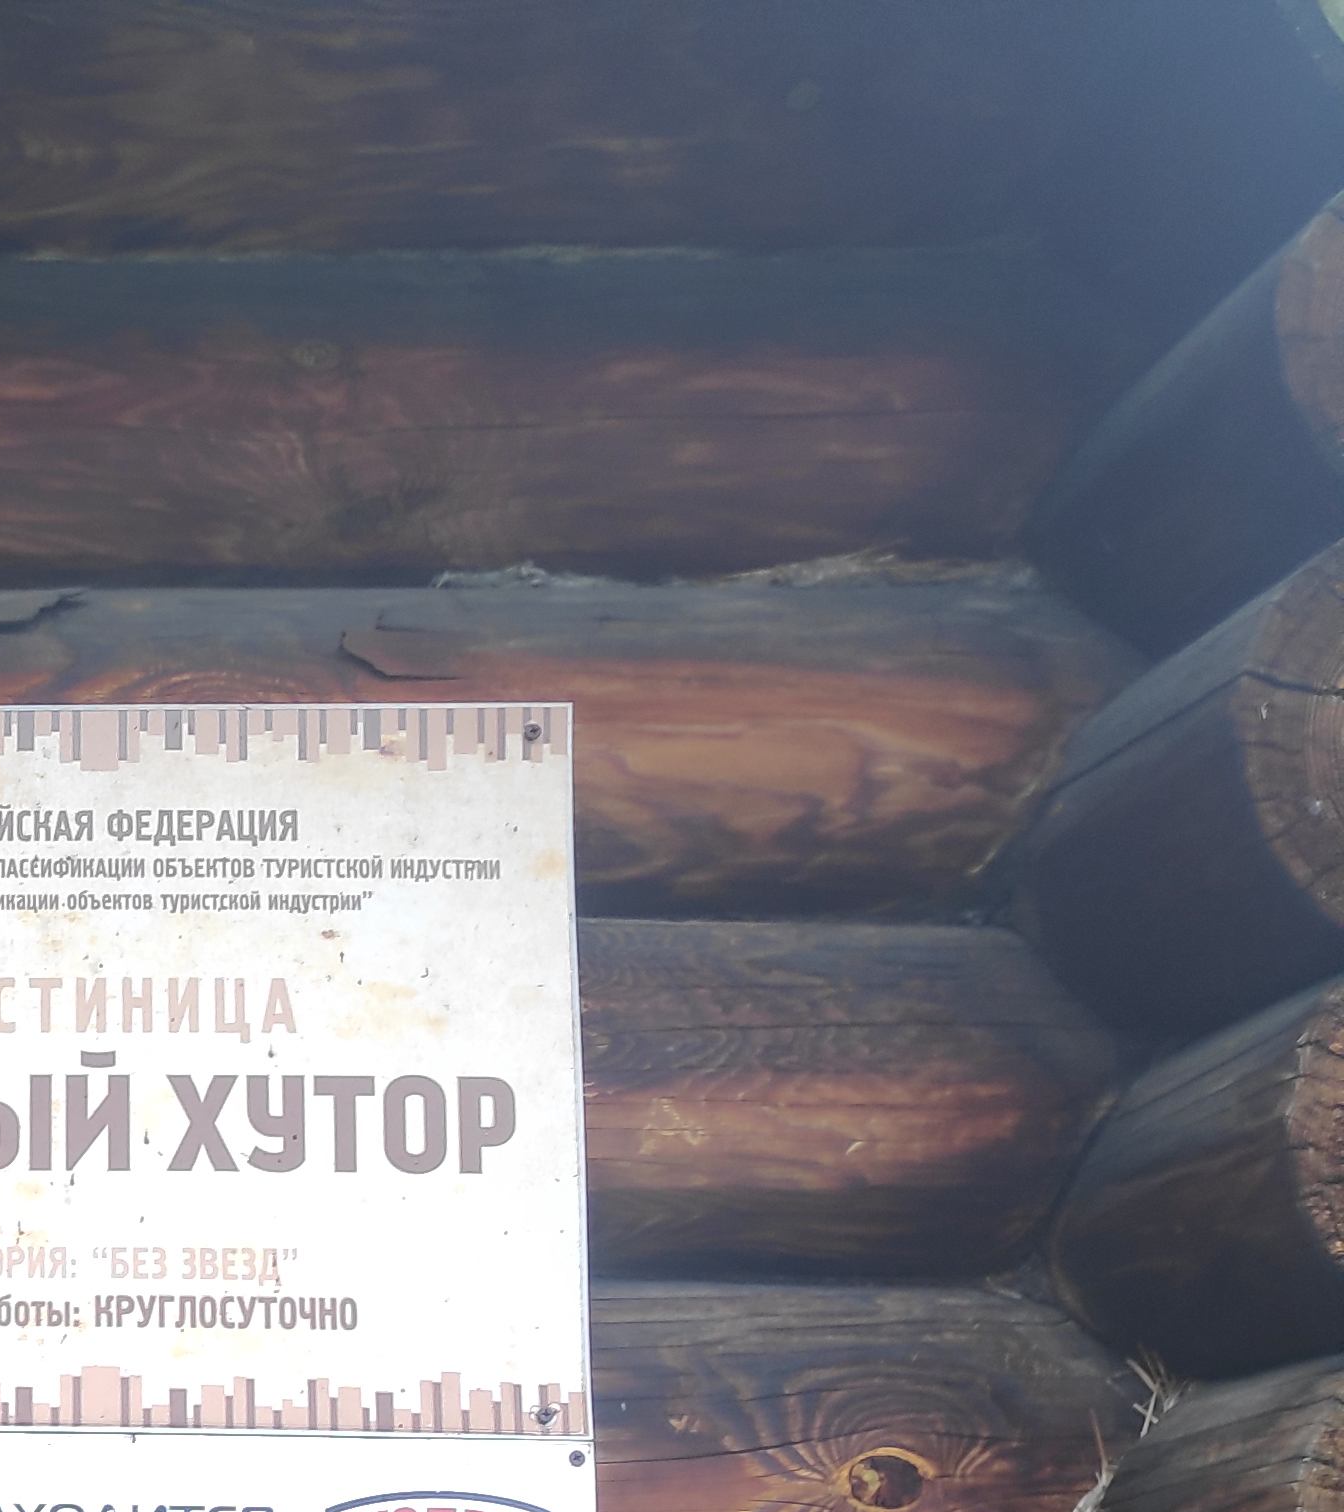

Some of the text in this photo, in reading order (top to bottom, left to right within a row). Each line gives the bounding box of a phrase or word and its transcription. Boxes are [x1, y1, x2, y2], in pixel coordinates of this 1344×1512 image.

[107, 809, 299, 847] ФЕДЕРАЦИЯ
[153, 857, 256, 880] ОБЪЕКТОВ
[263, 853, 384, 880] ТУРИСТСКОЙ
[391, 857, 501, 883] ИНДУСТРИИ
[67, 890, 153, 912] объектов
[162, 892, 260, 914] туристской
[166, 1074, 516, 1174] ХУТОР
[95, 1295, 358, 1331] КРУГЛОСУТОЧНО
